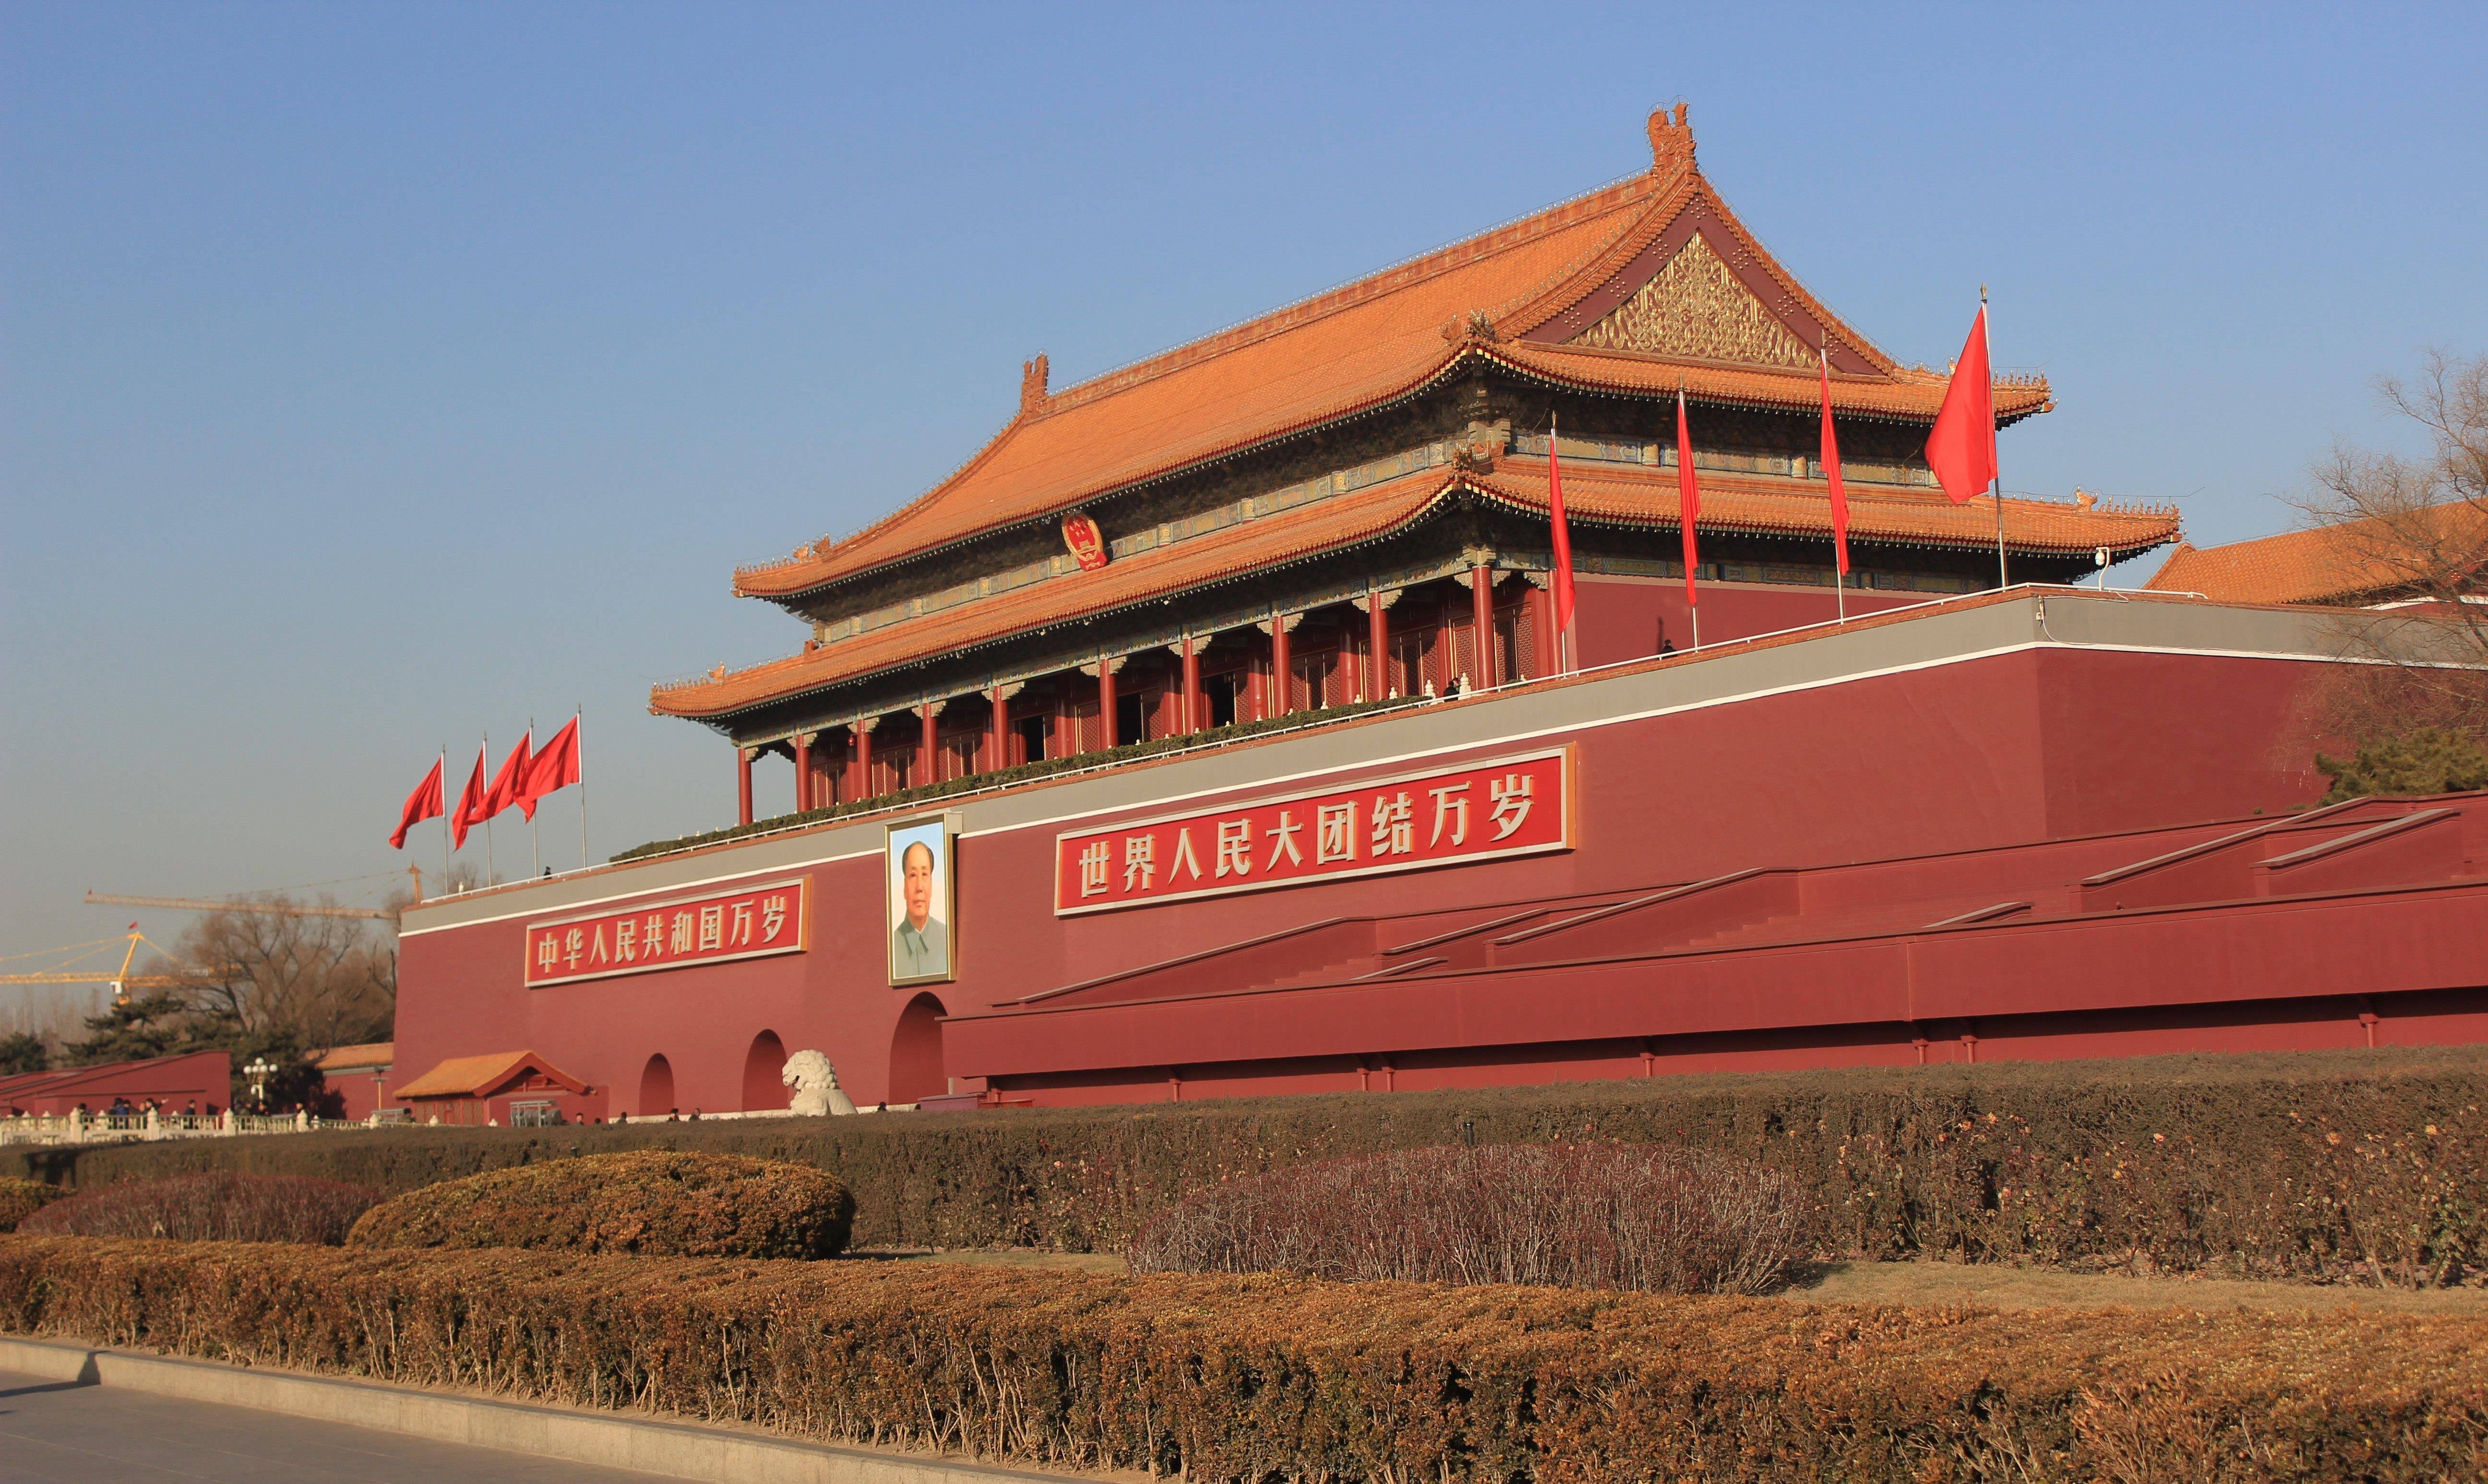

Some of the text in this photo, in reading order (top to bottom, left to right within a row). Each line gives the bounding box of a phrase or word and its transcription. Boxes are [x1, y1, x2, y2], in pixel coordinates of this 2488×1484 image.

[1079, 773, 1533, 898] 世界人民大团结万岁
[538, 895, 786, 973] 中华人民共和国万岁
